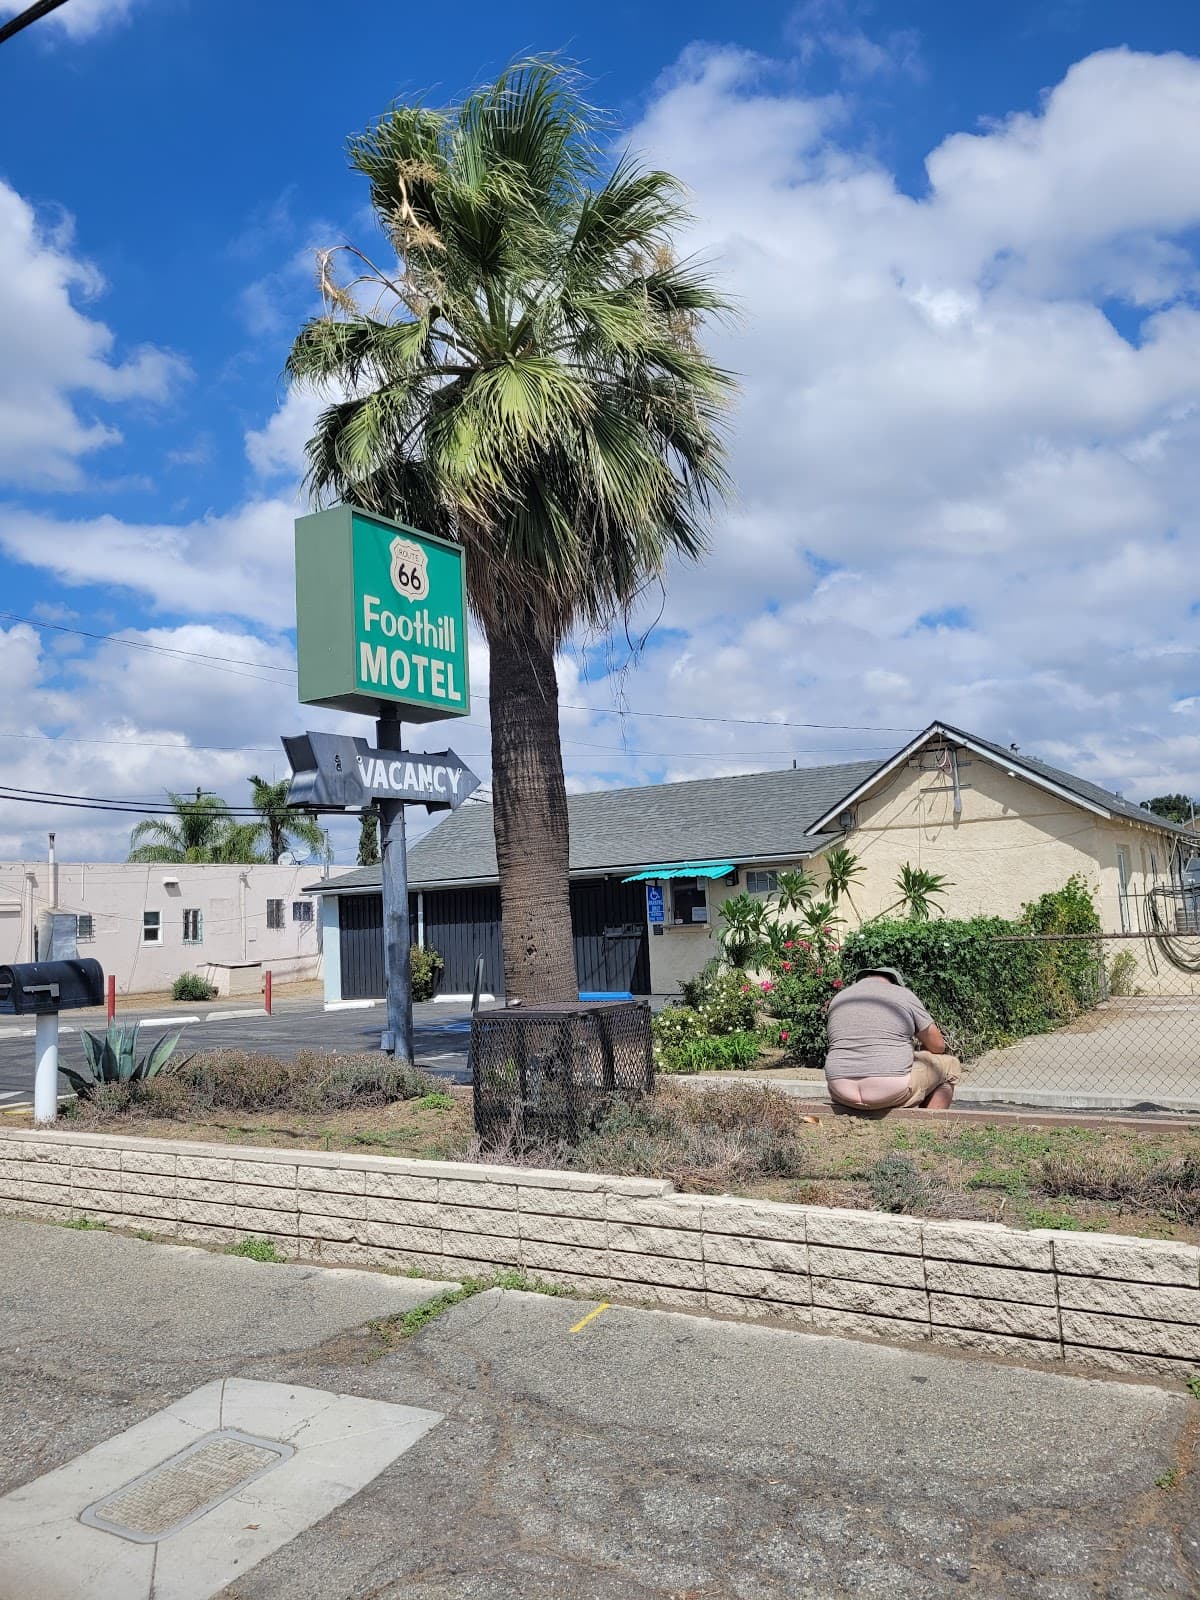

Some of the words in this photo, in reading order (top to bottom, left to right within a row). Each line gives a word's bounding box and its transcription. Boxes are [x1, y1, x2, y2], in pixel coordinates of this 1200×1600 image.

[398, 548, 423, 563] ROUTE
[398, 563, 422, 590] 66
[363, 594, 456, 653] Foothill
[359, 642, 461, 701] MOTEL
[356, 755, 463, 794] VACANCY
